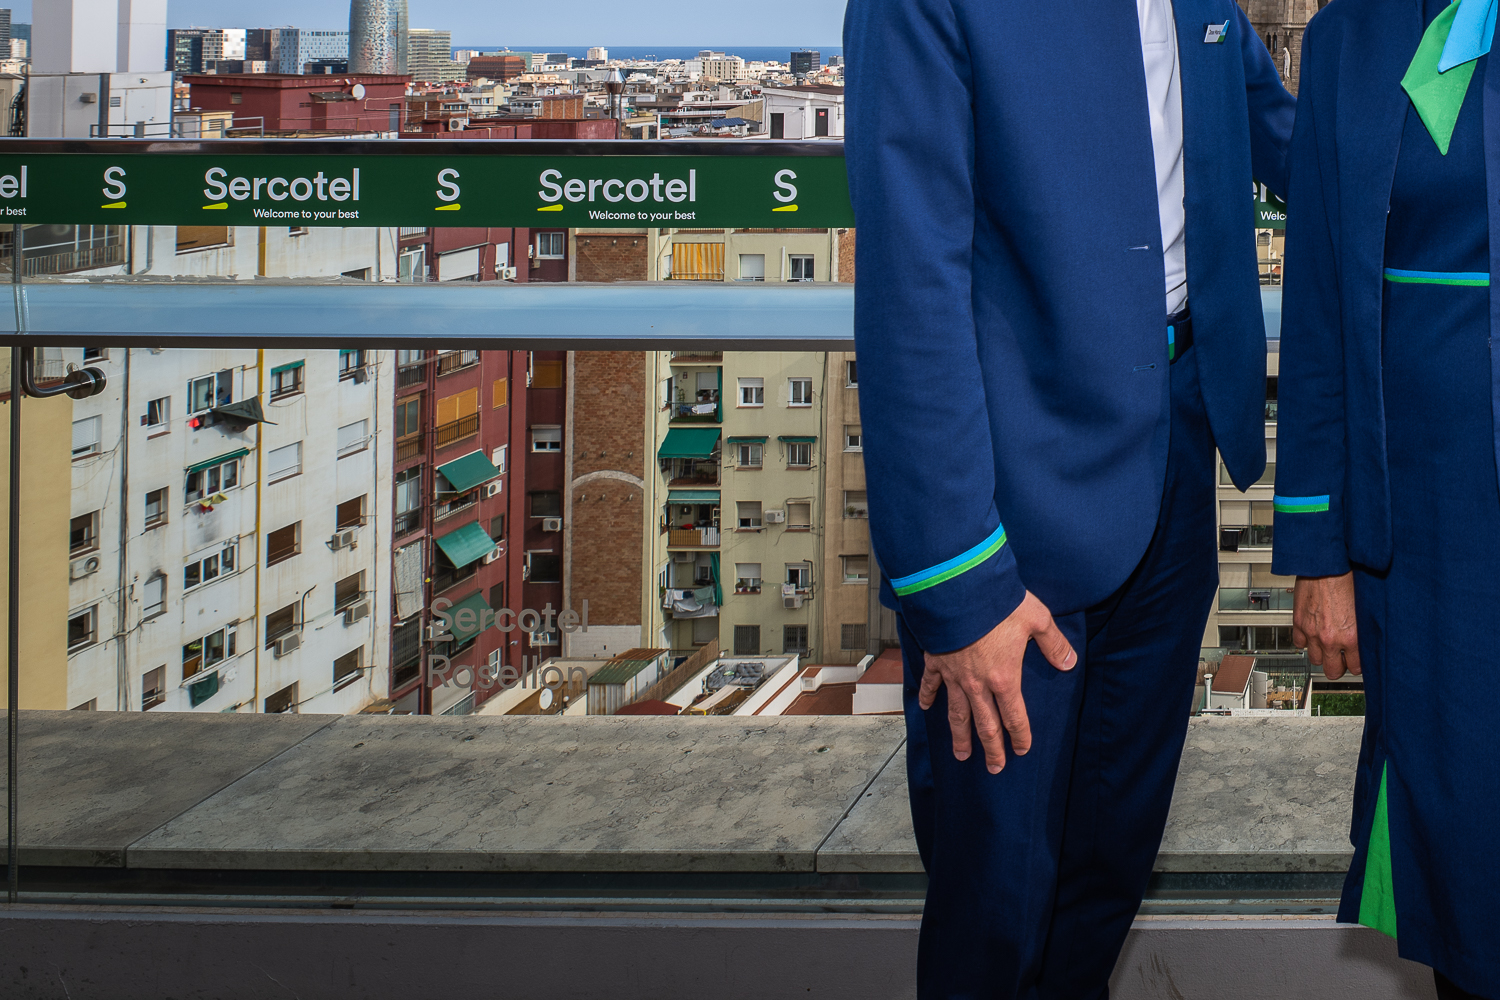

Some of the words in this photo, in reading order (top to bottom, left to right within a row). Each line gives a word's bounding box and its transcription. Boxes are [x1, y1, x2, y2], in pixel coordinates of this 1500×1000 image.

[102, 166, 127, 199] S
[203, 167, 360, 201] Sercotel
[436, 168, 461, 201] S
[538, 169, 696, 202] Sercotel
[772, 169, 798, 203] S
[6, 206, 27, 216] best
[253, 208, 300, 219] Welcome
[301, 209, 312, 219] to
[313, 211, 337, 221] your
[338, 209, 360, 219] best
[588, 210, 636, 220] Welcome
[637, 211, 648, 220] to
[649, 212, 673, 222] your
[674, 210, 696, 220] best
[430, 597, 589, 633] Sercotel
